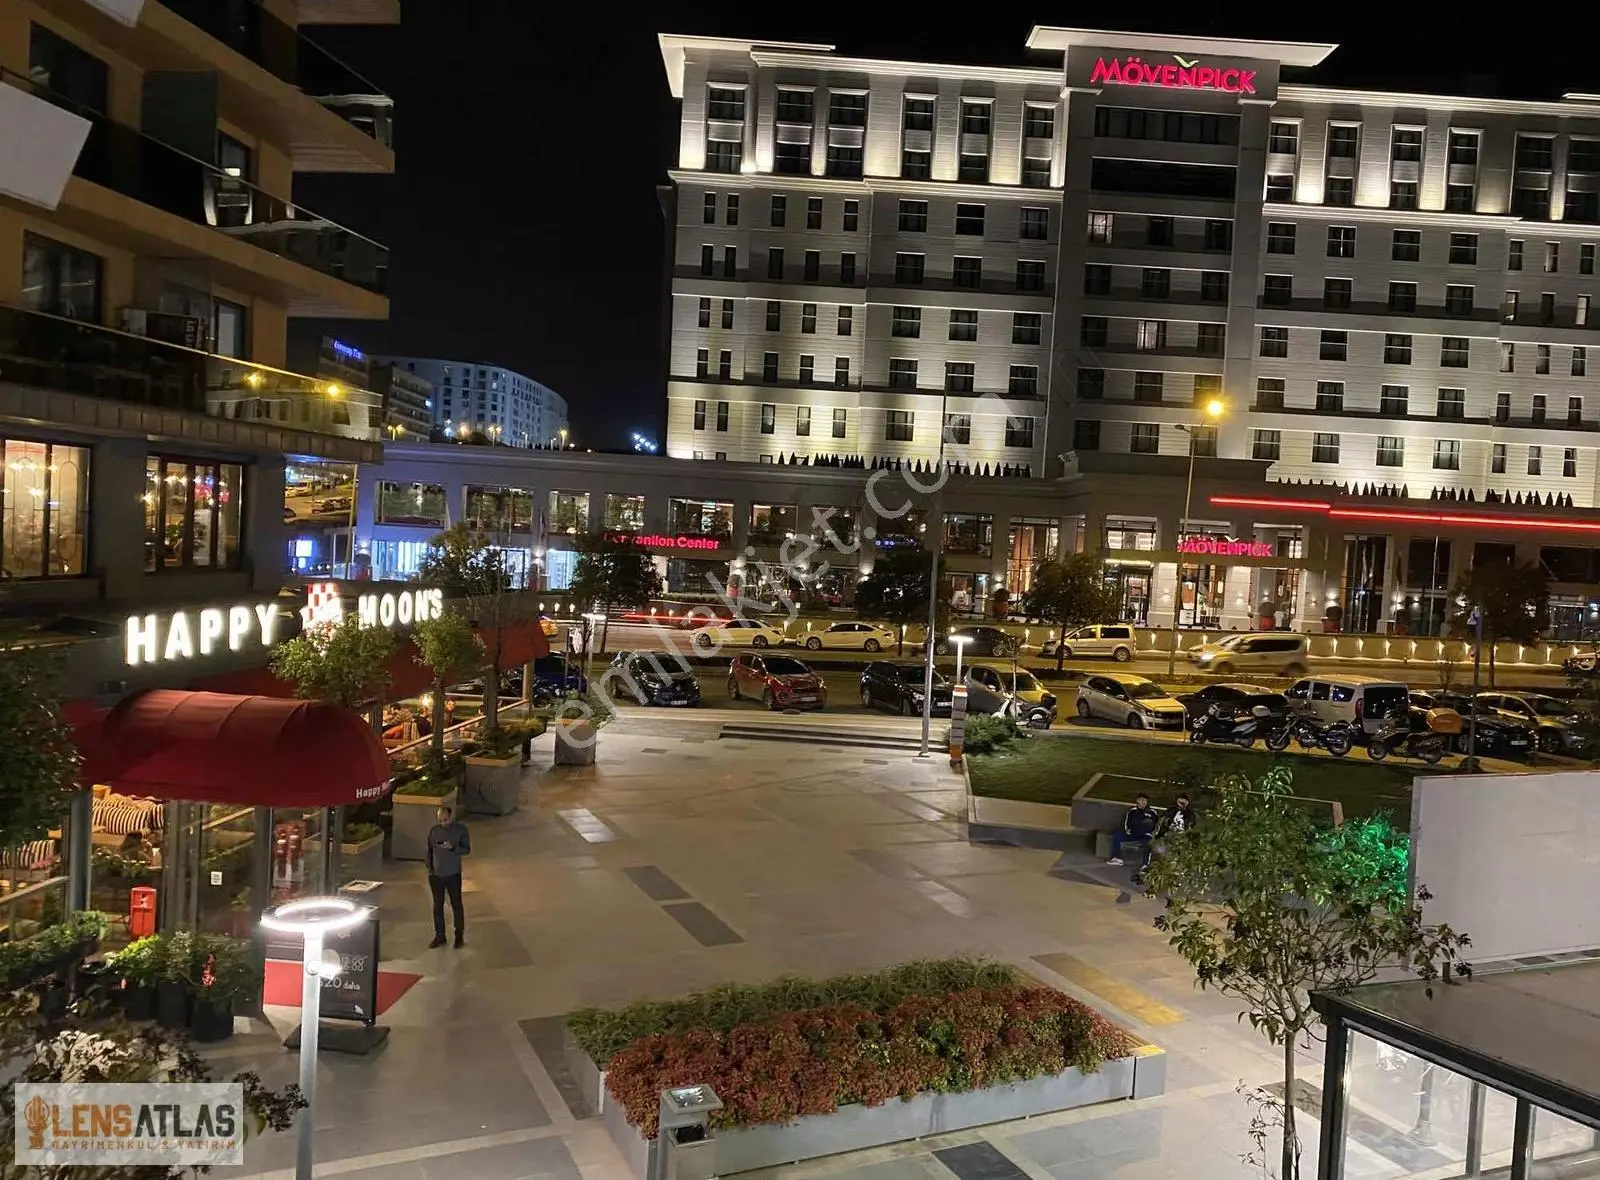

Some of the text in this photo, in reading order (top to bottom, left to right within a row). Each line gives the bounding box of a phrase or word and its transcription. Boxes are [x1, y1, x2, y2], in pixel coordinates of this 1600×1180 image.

[1090, 56, 1257, 95] MÖVENPICK
[677, 535, 720, 550] Center
[126, 603, 280, 667] HAPPY
[358, 588, 443, 631] MOON'S
